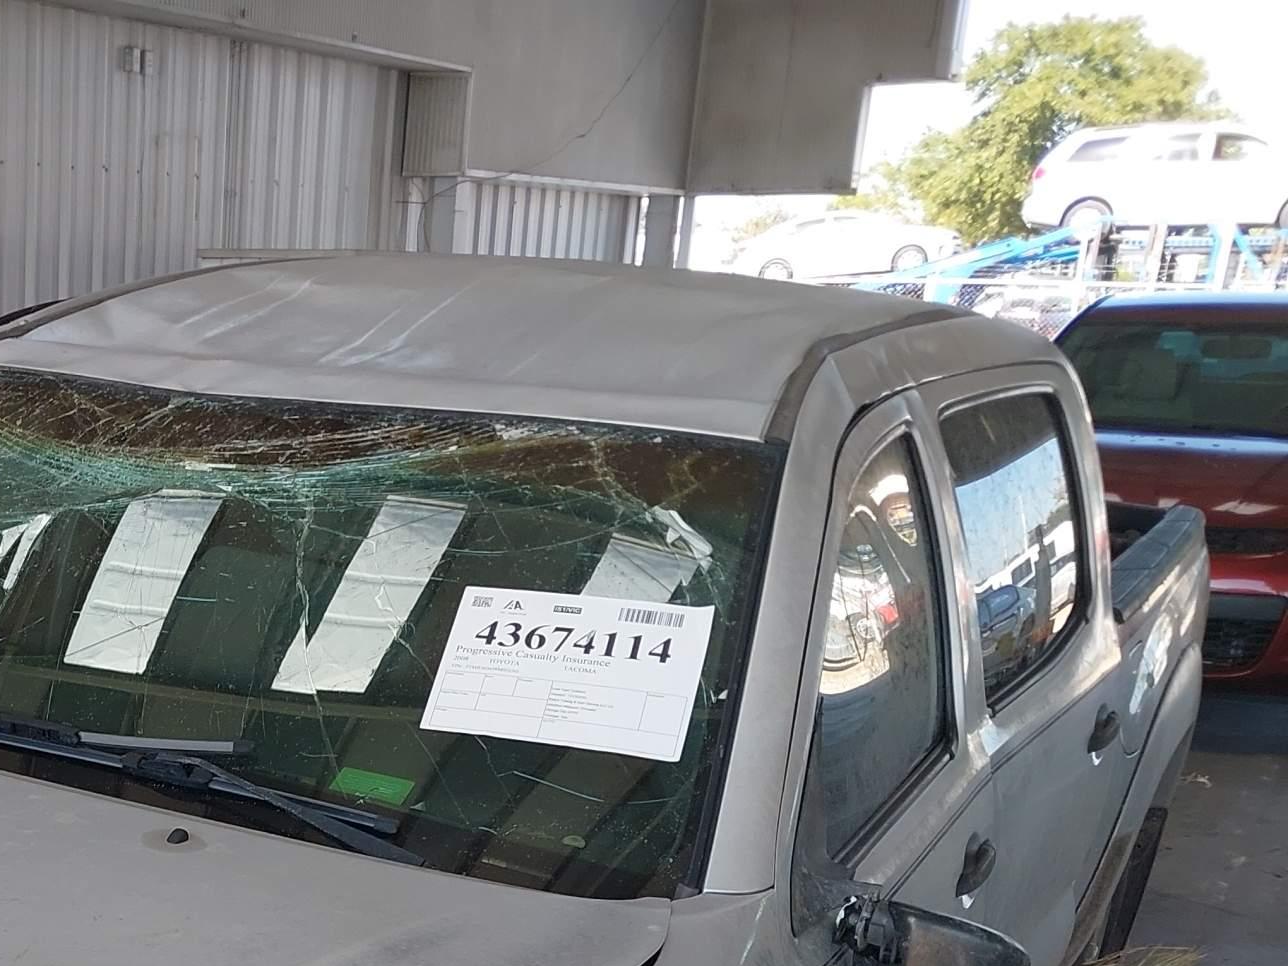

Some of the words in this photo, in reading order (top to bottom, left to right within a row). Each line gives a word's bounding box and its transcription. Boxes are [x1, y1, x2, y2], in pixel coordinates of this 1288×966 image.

[475, 620, 673, 664] 43674114
[455, 644, 513, 658] Progressive
[515, 650, 559, 663] Casualty
[562, 654, 611, 668] Insurance
[489, 658, 520, 667] TOYOTA
[564, 666, 597, 674] TACOMA
